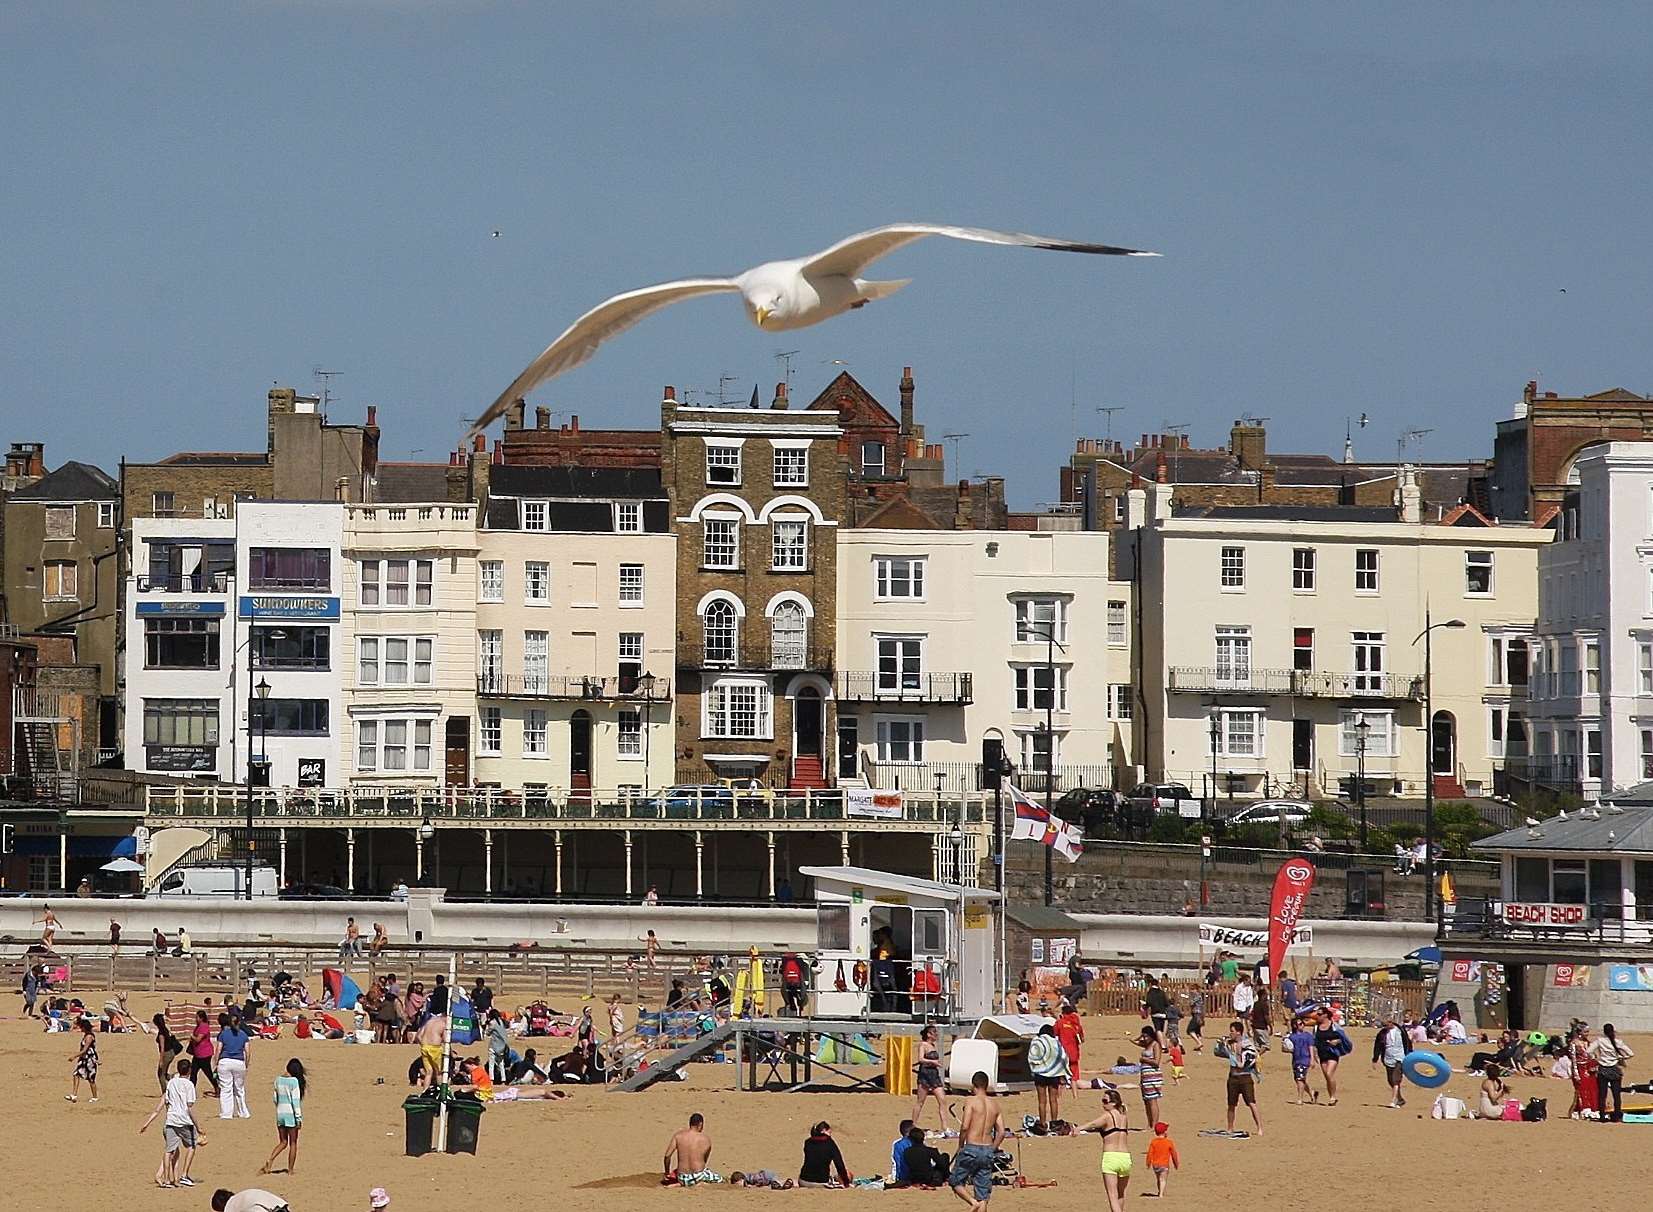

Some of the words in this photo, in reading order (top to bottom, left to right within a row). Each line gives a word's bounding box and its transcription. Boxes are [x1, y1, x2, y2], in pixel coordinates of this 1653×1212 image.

[252, 598, 328, 610] SUNDOWNERS
[301, 763, 321, 776] BAR
[1274, 895, 1294, 925] Love
[1506, 905, 1546, 922] BEACH
[1551, 907, 1583, 924] SHOP
[1213, 929, 1265, 946] BEACH
